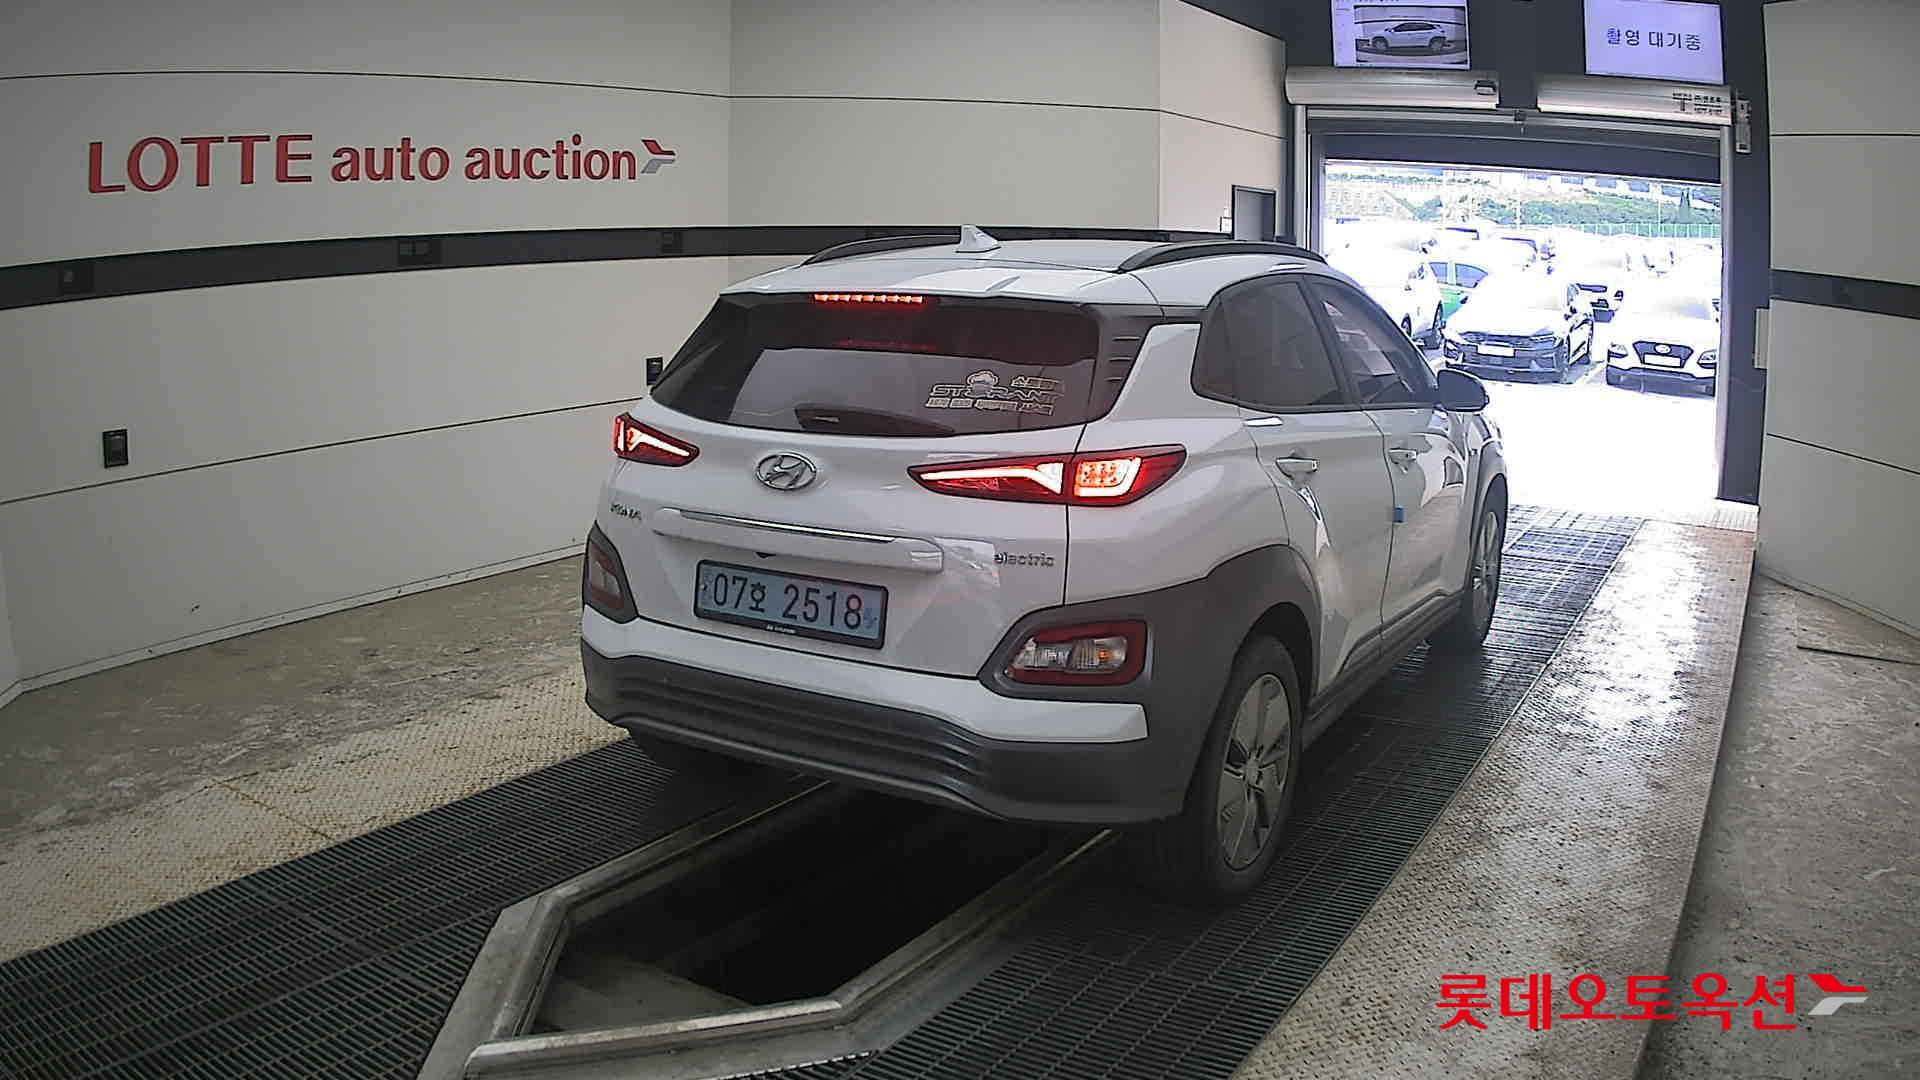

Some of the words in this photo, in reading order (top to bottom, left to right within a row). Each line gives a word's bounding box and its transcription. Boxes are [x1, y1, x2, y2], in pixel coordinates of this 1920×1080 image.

[1607, 27, 1640, 46] 촬영
[1647, 31, 1701, 51] 대기중
[88, 134, 313, 193] LOTTE
[331, 137, 450, 181] auto
[463, 133, 637, 180] auction
[993, 551, 1055, 567] electric
[713, 573, 767, 613] 07호
[782, 584, 862, 630] 2518
